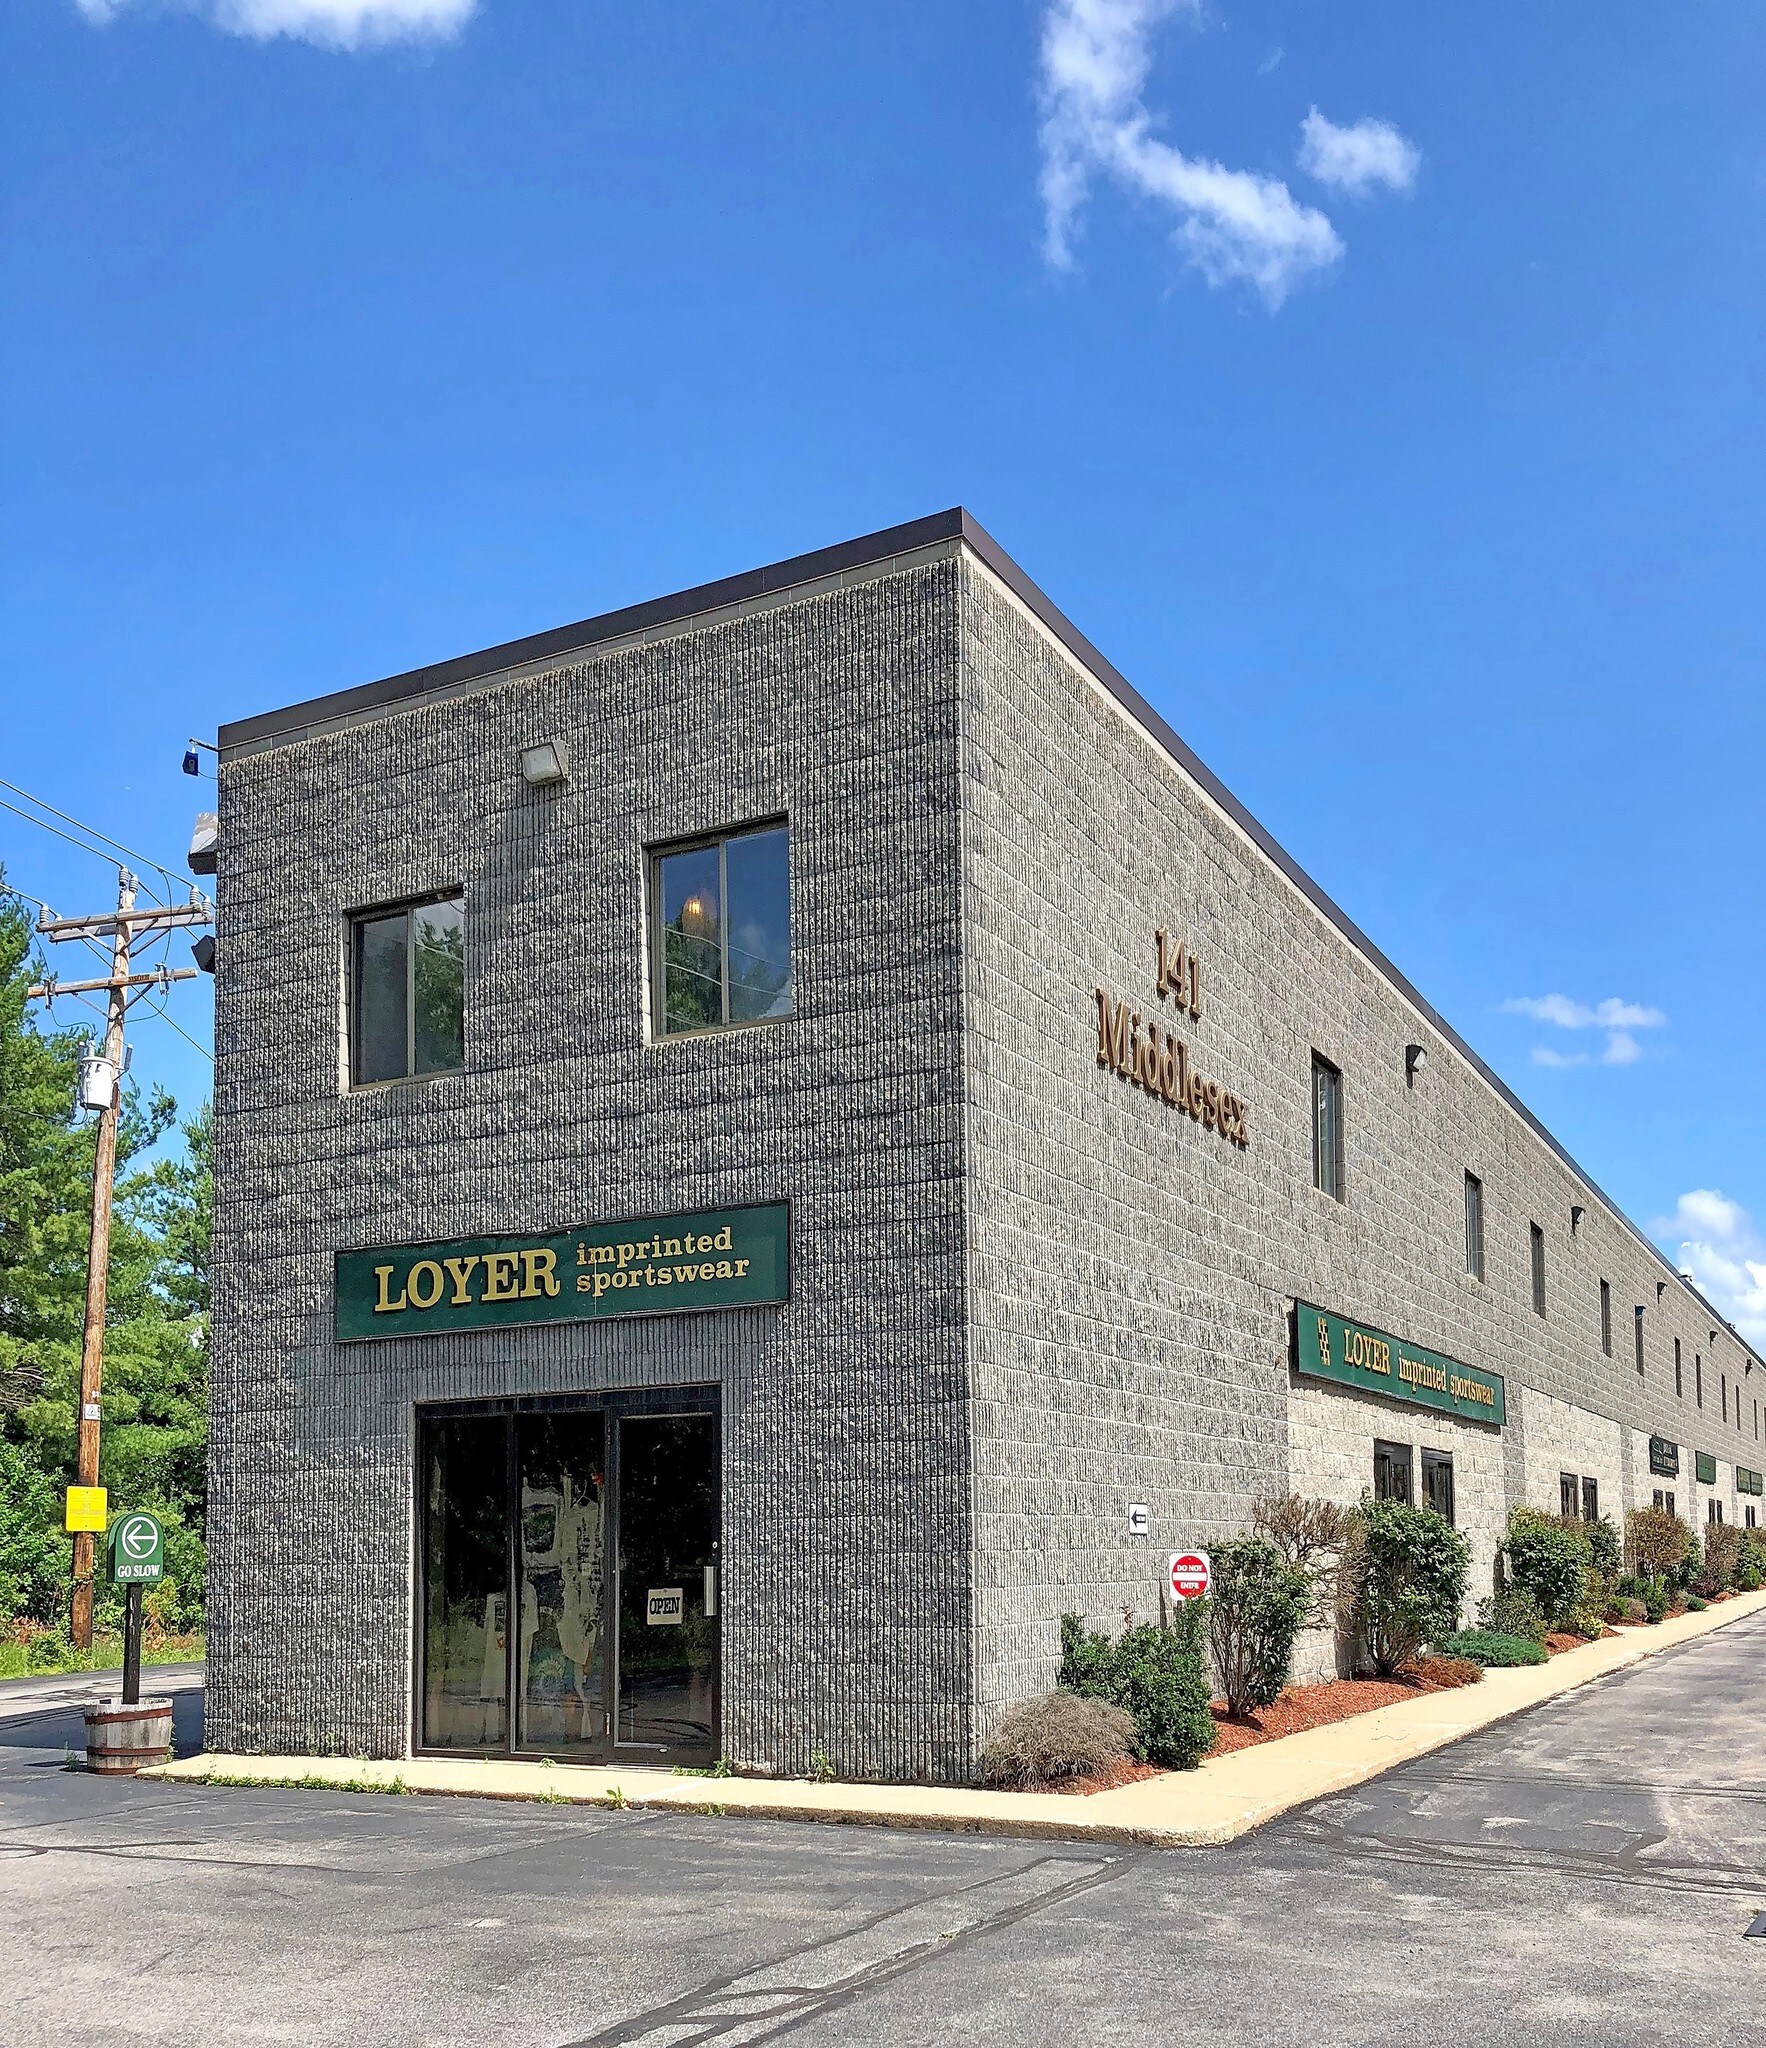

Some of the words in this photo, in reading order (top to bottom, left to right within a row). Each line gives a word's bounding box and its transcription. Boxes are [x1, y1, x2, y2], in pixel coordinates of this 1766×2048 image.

[1155, 925, 1202, 1018] 141
[1096, 987, 1249, 1145] Middlesex
[576, 1226, 733, 1267] imprinted
[373, 1248, 560, 1313] LOYER
[576, 1257, 750, 1297] sportswear
[1343, 1328, 1391, 1375] LOYER
[1398, 1348, 1447, 1393] imprinted
[1449, 1374, 1495, 1406] sportswear
[117, 1565, 132, 1577] GO
[133, 1564, 160, 1577] SLOW
[1176, 1564, 1188, 1572] DO
[1188, 1564, 1203, 1572] NOT
[649, 1596, 680, 1615] OPEN
